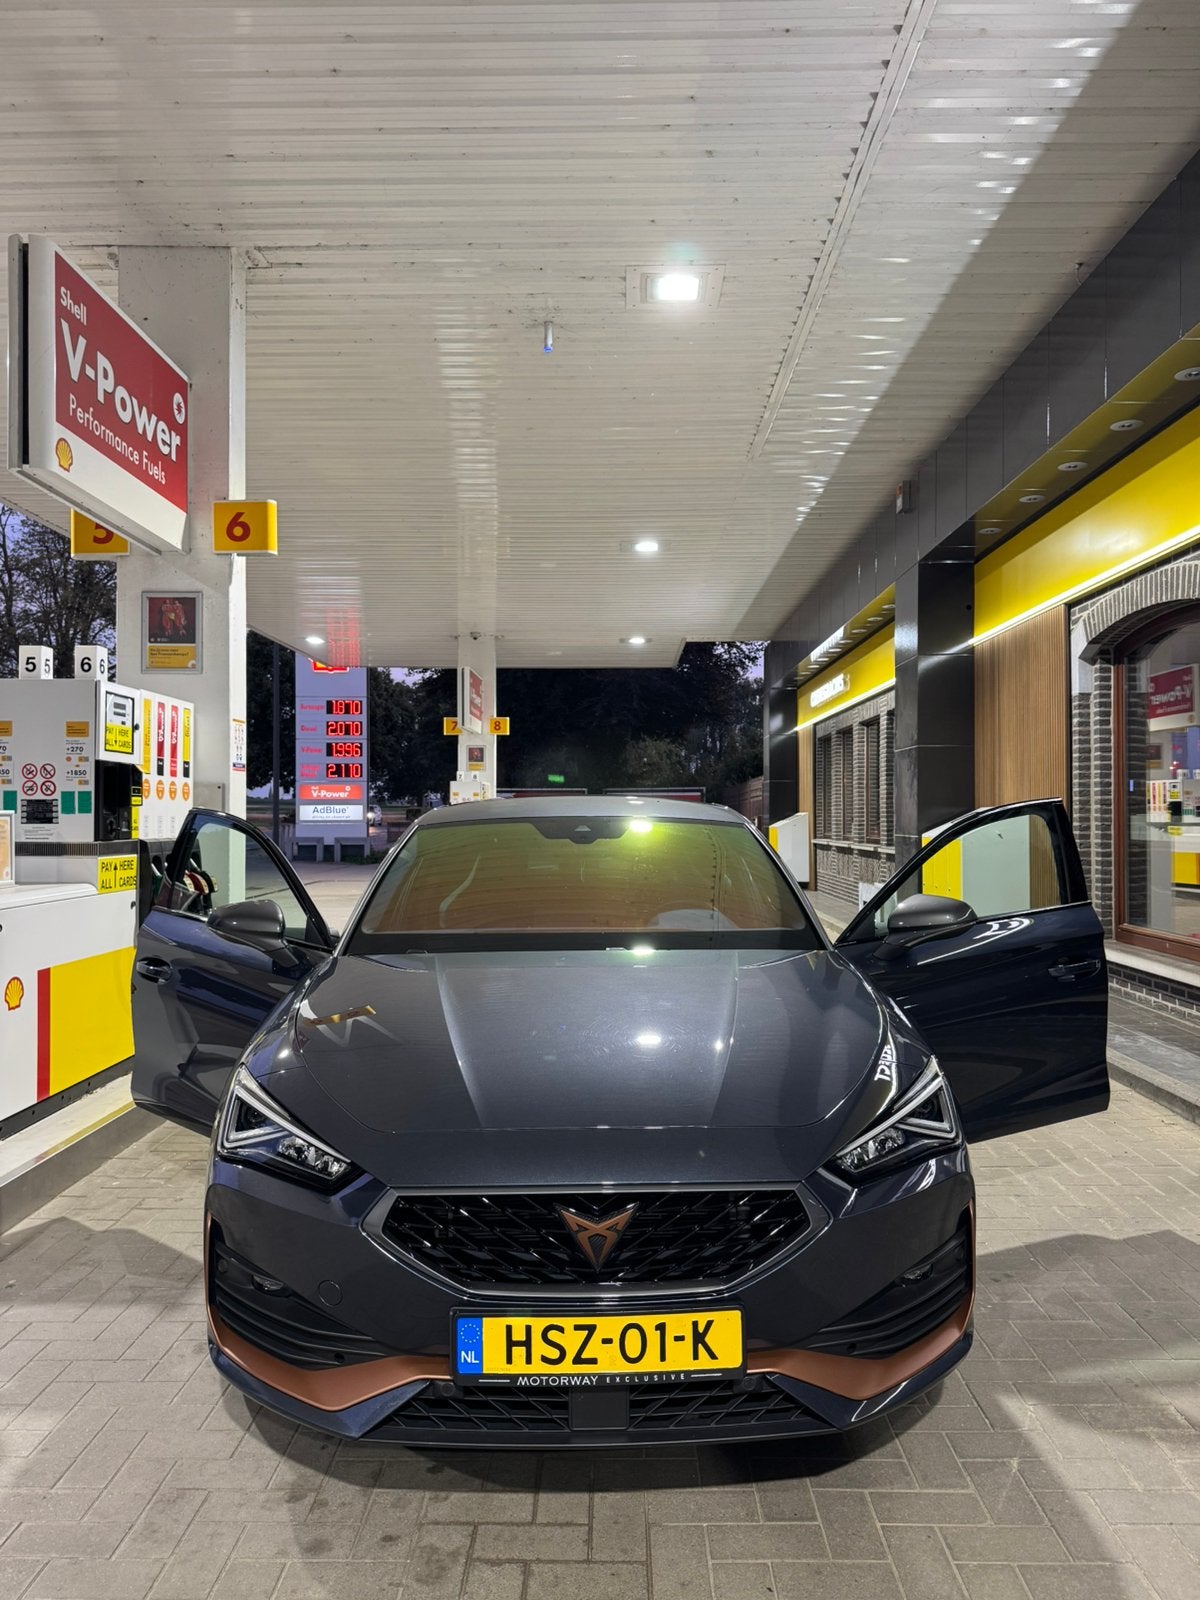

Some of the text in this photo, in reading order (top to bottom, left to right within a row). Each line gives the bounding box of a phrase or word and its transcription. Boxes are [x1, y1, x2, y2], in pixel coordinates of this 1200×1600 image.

[60, 286, 87, 326] Shell
[61, 318, 181, 462] V-Power
[69, 392, 166, 485] Performance Fuels
[226, 512, 250, 542] 6
[25, 656, 36, 672] 5
[44, 658, 51, 674] 5
[80, 656, 92, 672] 6
[99, 658, 105, 674] 6
[327, 722, 361, 736] 2.070
[451, 721, 458, 731] 7
[494, 721, 501, 731] 8
[332, 743, 361, 757] 1.996
[327, 763, 361, 778] 2.110
[311, 790, 350, 798] V-Power
[312, 806, 347, 814] AdBlue
[101, 859, 134, 873] PAY HERE
[101, 875, 137, 890] ALL CARDS
[505, 1320, 719, 1365] HSZ-01-K
[461, 1351, 480, 1364] NL
[517, 1373, 685, 1386] MOTORWAY EXCLUSIVE
